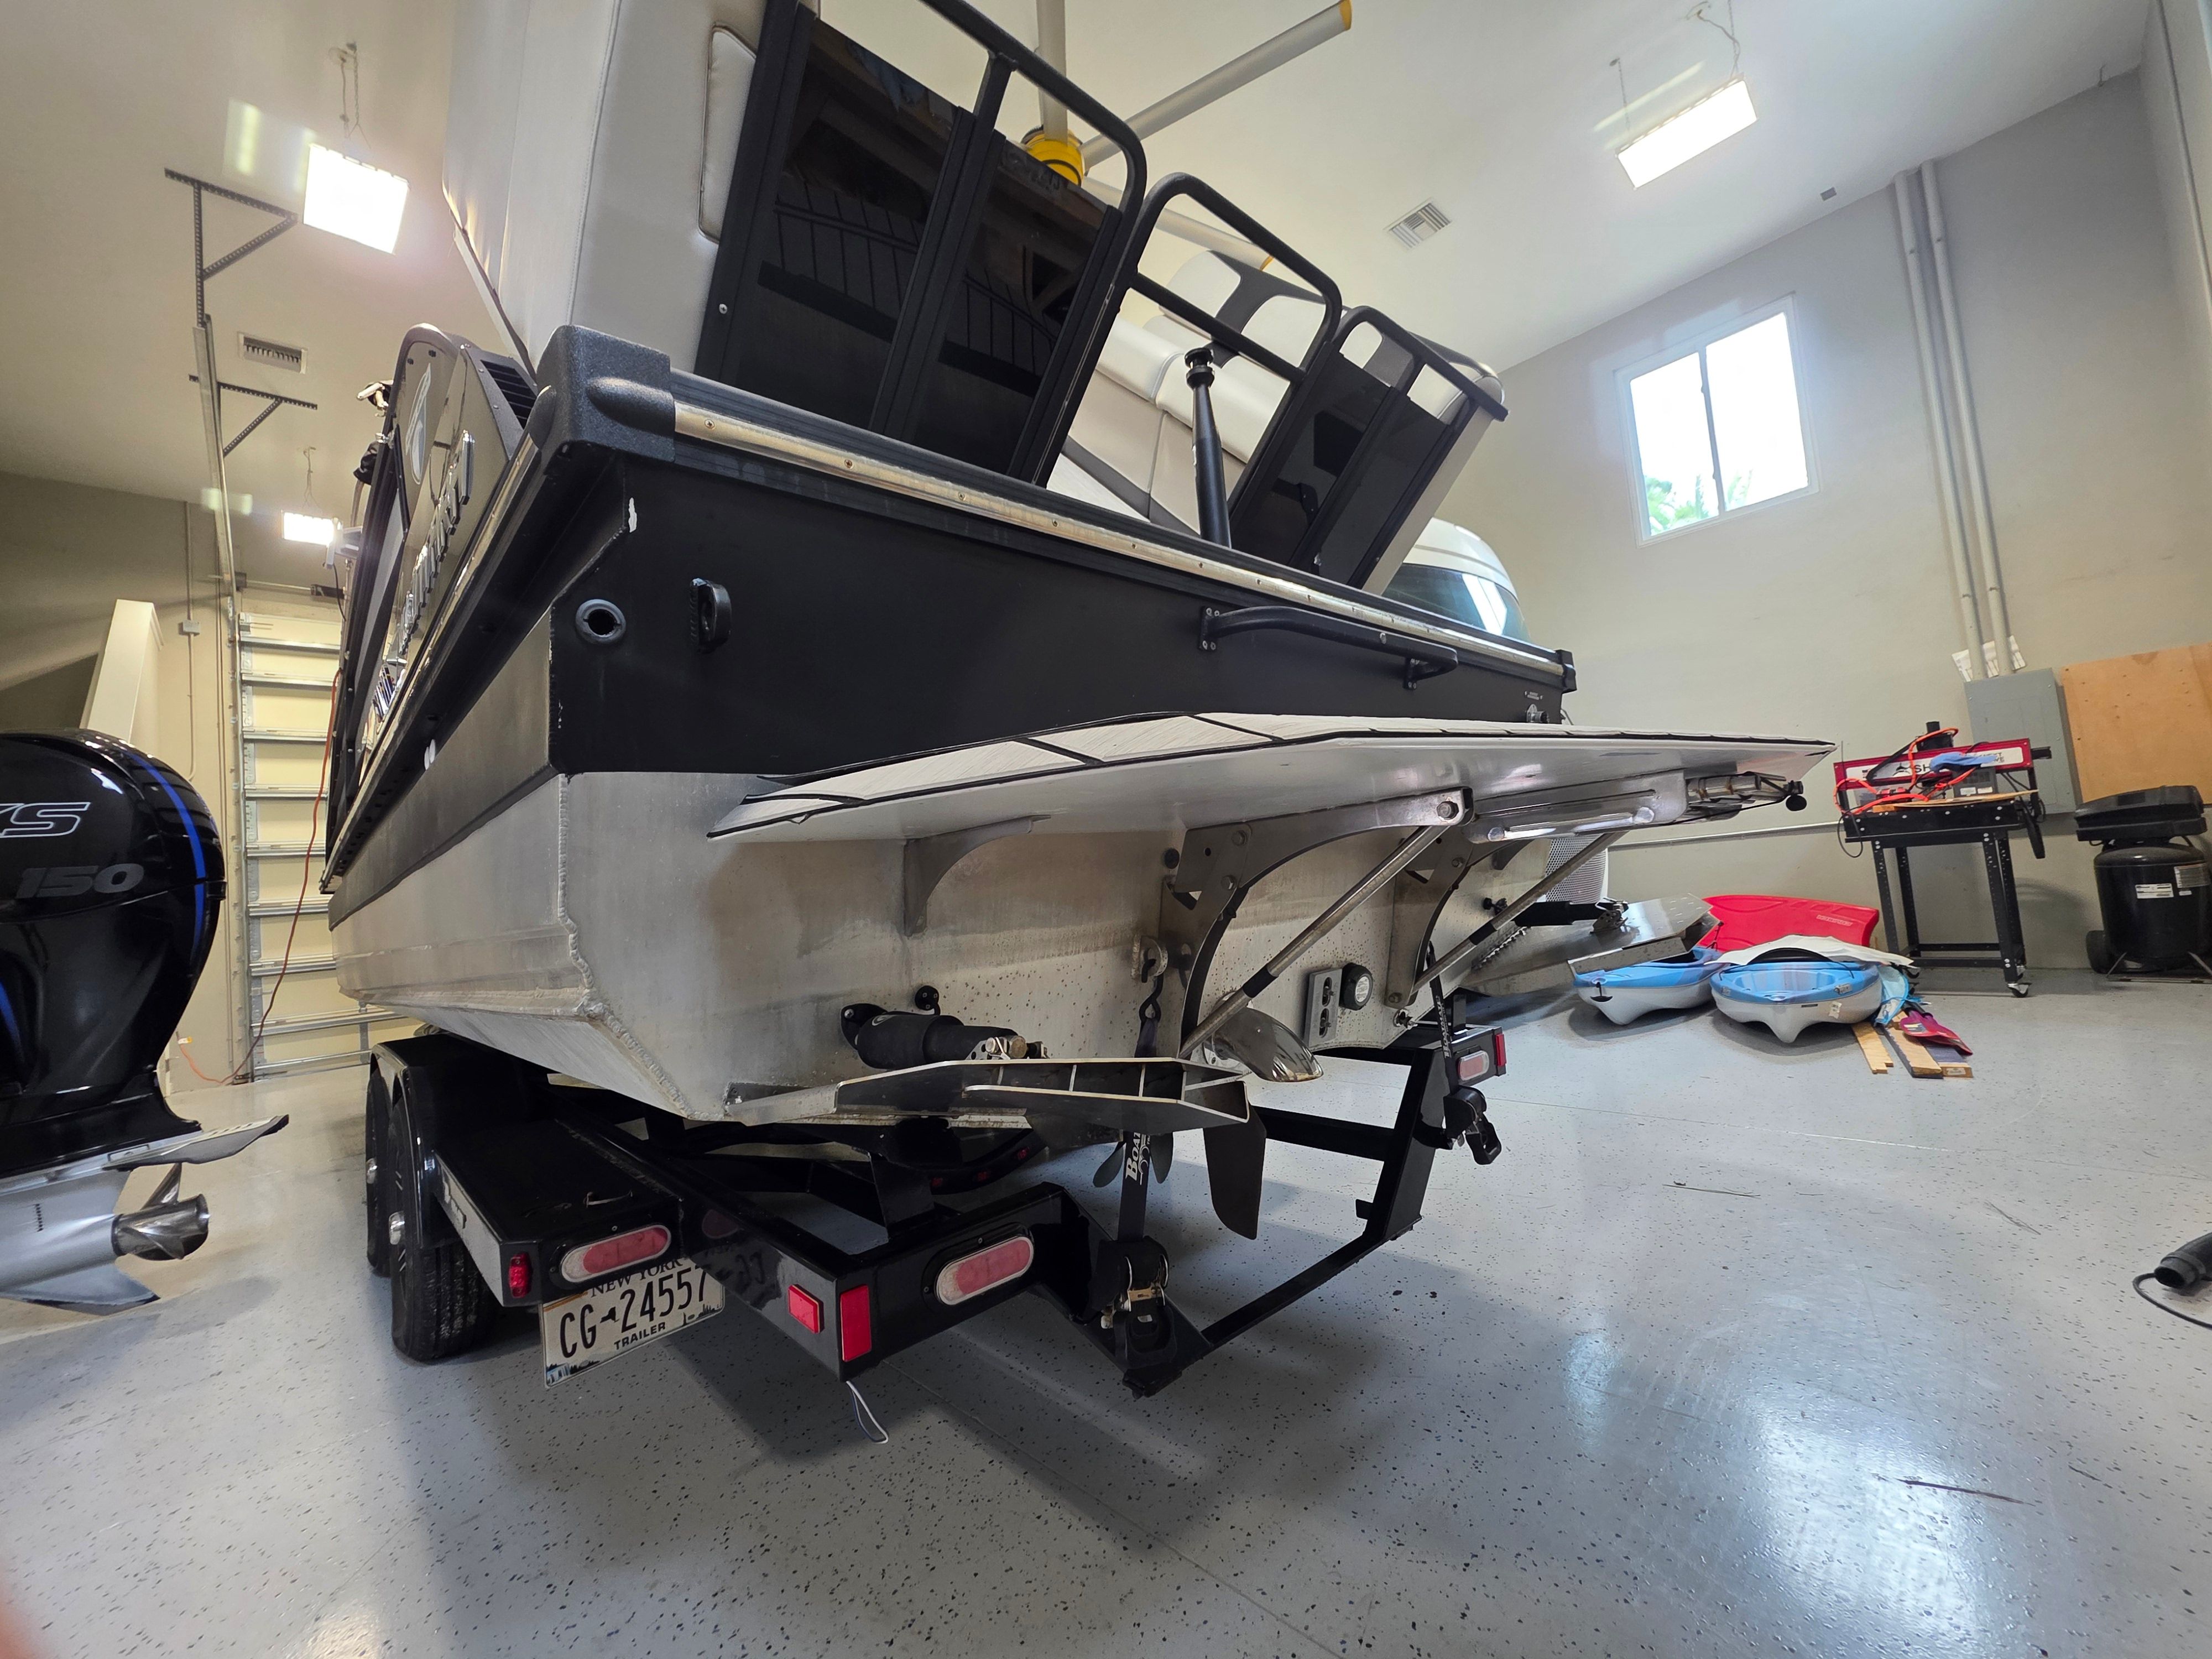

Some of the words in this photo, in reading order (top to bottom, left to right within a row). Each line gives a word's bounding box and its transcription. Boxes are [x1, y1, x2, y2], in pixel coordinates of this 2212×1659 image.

[15, 863, 144, 899] 150
[591, 1275, 632, 1298] NEW
[640, 1259, 683, 1280] YORK
[560, 1303, 597, 1358] CG
[619, 1266, 708, 1333] 24557
[614, 1322, 666, 1350] TRAILER
